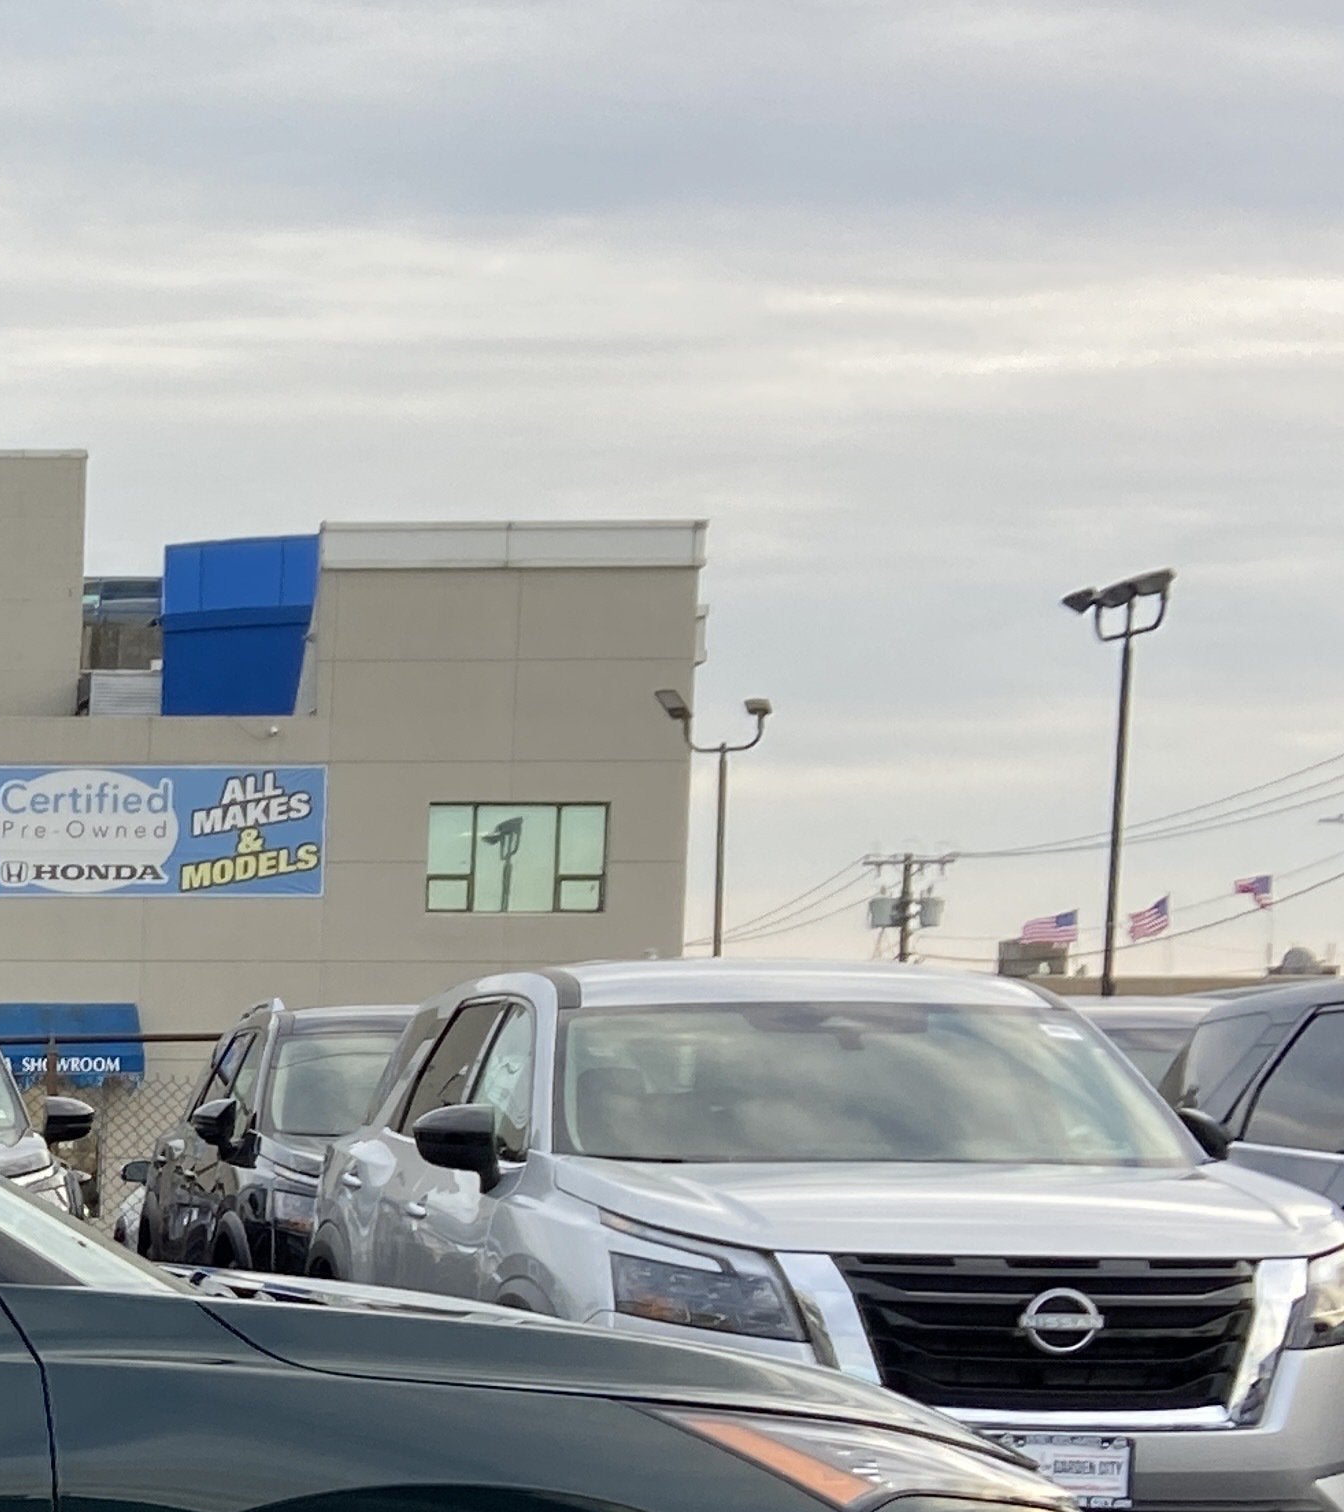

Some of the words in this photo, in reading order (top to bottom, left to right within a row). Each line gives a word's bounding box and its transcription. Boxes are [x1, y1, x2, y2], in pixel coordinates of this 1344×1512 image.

[2, 782, 170, 814] Certified
[220, 772, 284, 805] ALL
[191, 791, 312, 837] MAKES
[2, 820, 167, 839] Pre-Owned
[235, 826, 264, 854] &
[33, 864, 163, 881] HONDA
[180, 843, 319, 892] MODELS
[1023, 1314, 1104, 1328] NISSAN
